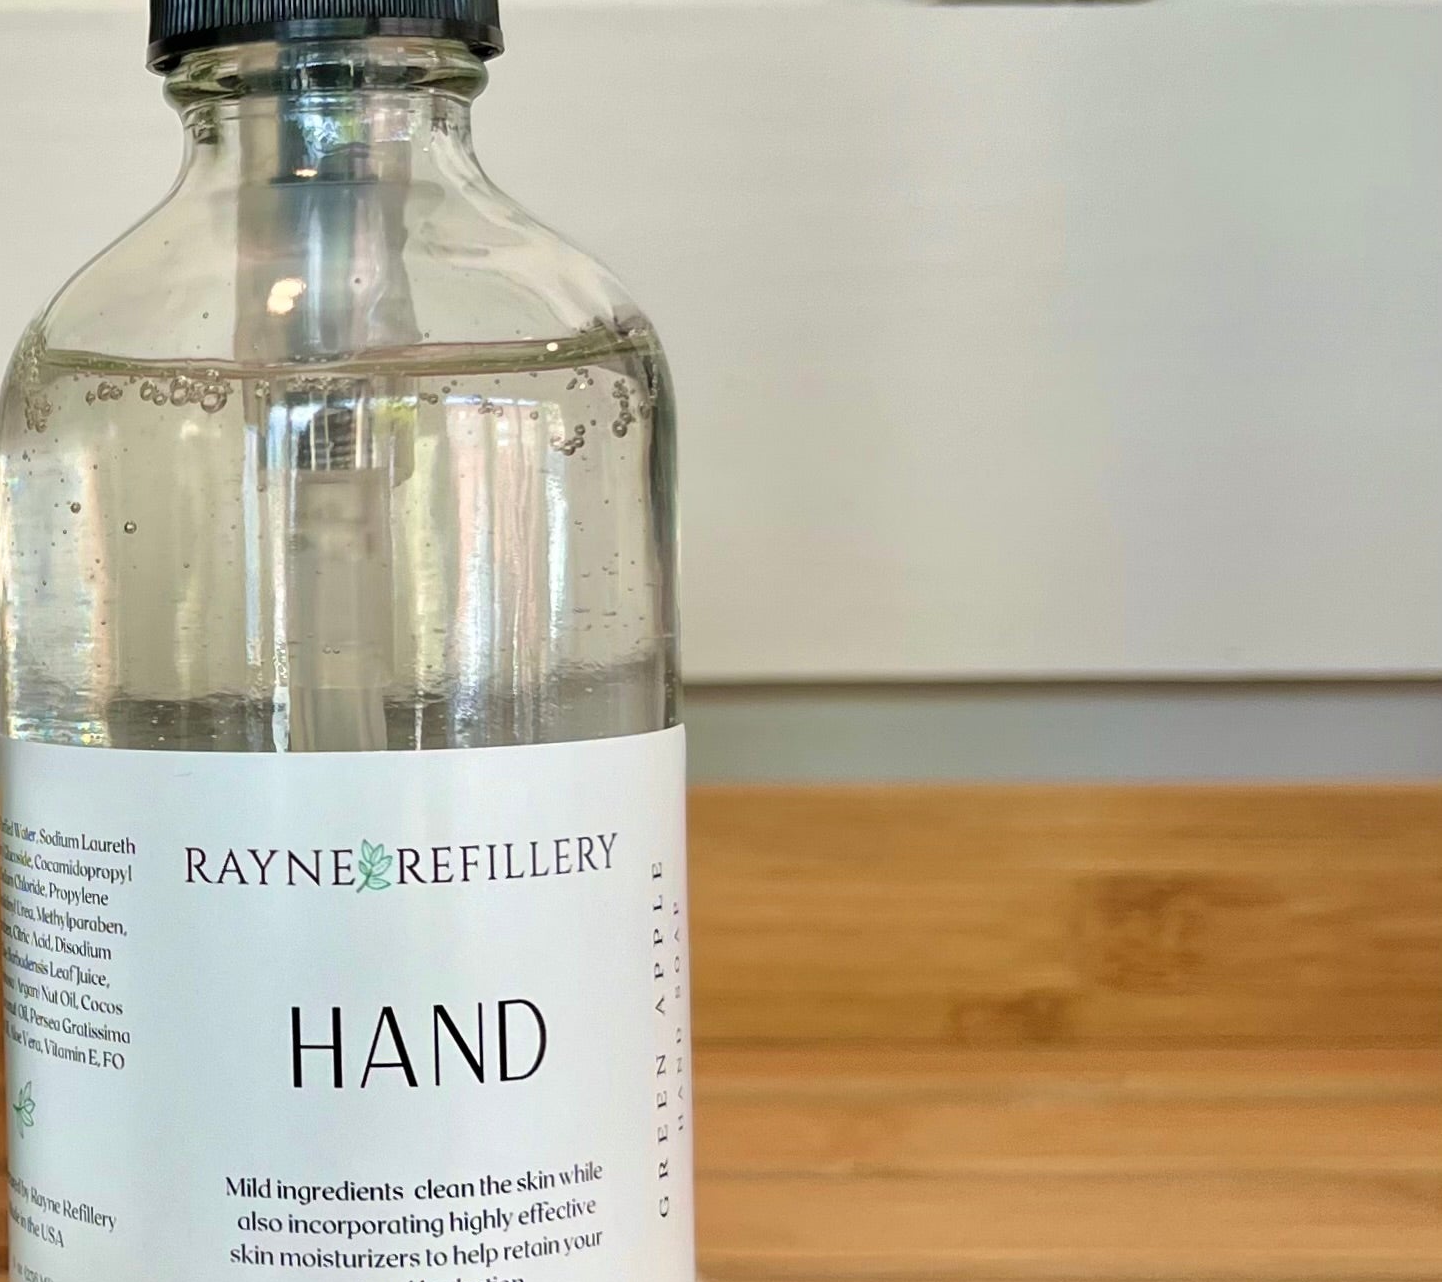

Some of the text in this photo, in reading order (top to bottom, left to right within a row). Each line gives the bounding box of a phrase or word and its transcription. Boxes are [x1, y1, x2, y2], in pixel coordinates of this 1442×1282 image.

[39, 828, 79, 850] Sodium
[81, 833, 136, 855] Laureth
[34, 854, 133, 886] Cocamidopropyl
[184, 832, 619, 888] RAYNE REFILLERY
[49, 882, 109, 907] Propylene
[36, 905, 128, 937] Methylparaben,
[55, 935, 112, 961] Disodium
[49, 961, 76, 982] Leaf
[76, 966, 111, 989] Juice,
[40, 985, 59, 1006] Nut
[80, 993, 124, 1016] Cocos
[62, 1017, 132, 1045] Gratissima
[290, 997, 549, 1090] HAND
[651, 860, 670, 1219] GREEN APPLE
[44, 1037, 87, 1064] Vitamin
[102, 1050, 126, 1071] FO
[225, 1160, 604, 1206] Mild ingredients clean the skin while
[30, 1186, 61, 1215] Rayne
[62, 1199, 118, 1234] Refillery
[237, 1198, 597, 1240] also incorporating highly effective
[41, 1222, 65, 1249] USA
[229, 1229, 604, 1269] skin moisturizers to help retain your
